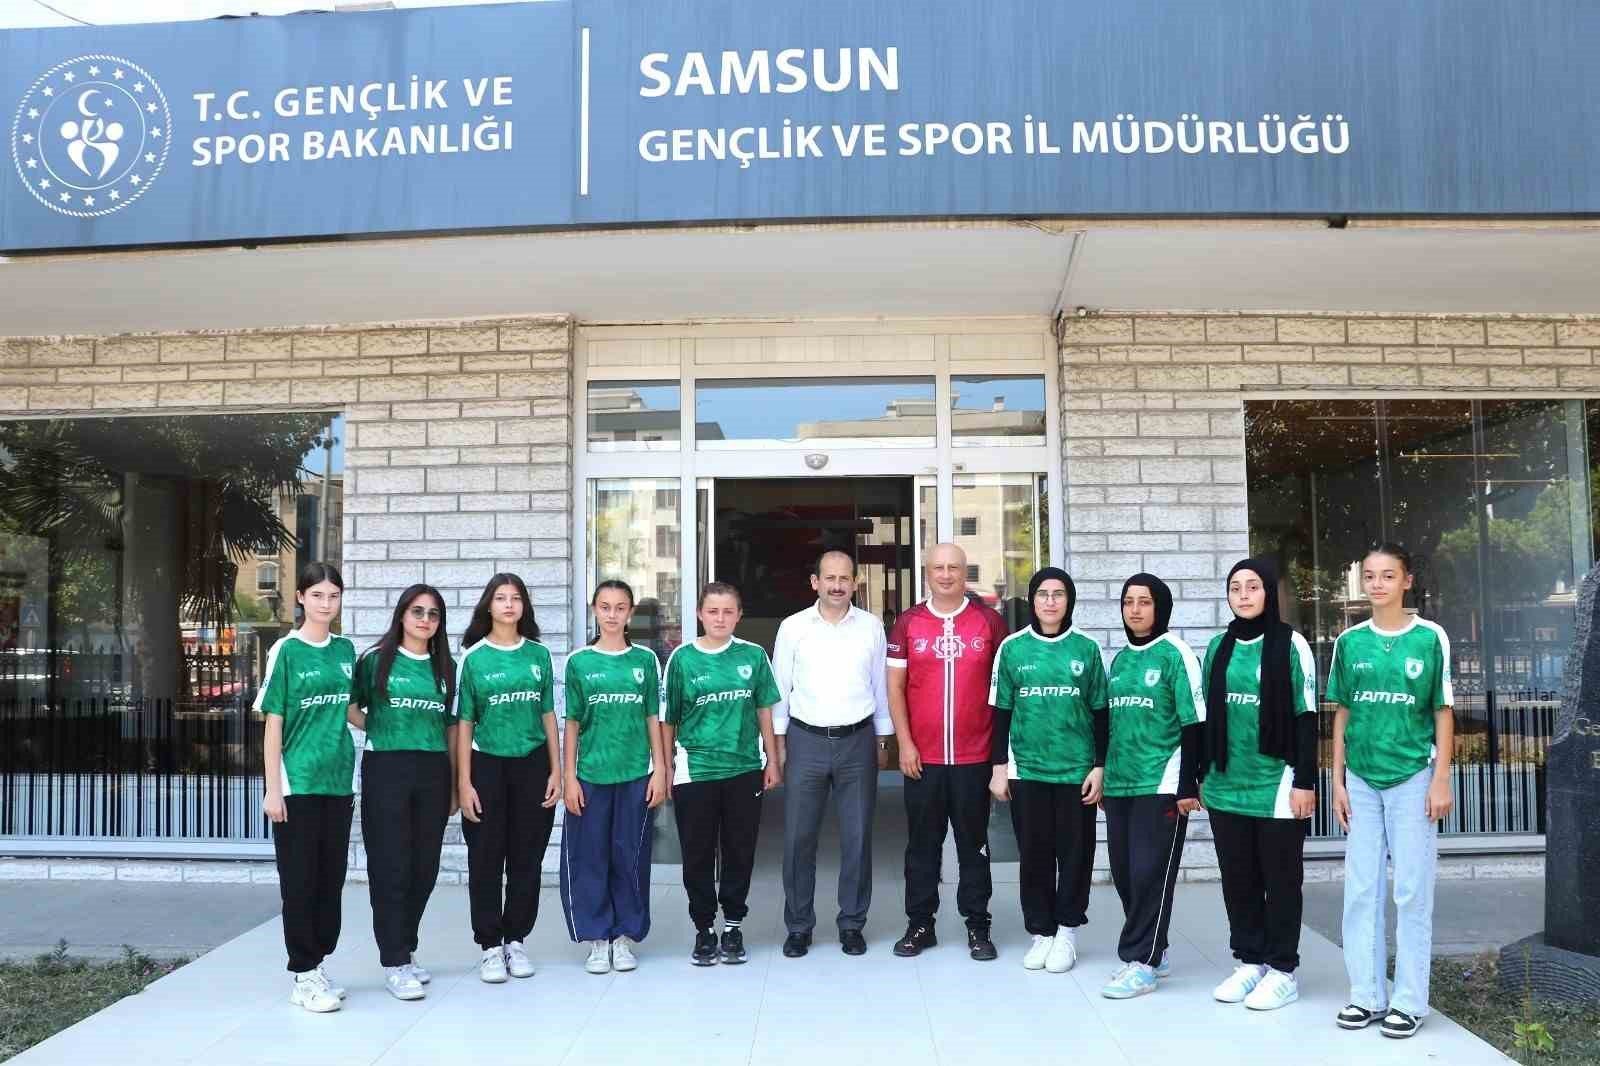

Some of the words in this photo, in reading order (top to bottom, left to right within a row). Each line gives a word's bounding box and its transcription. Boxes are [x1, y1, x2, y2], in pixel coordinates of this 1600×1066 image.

[639, 46, 899, 98] SAMSUN
[192, 92, 262, 122] T.C.
[273, 74, 448, 122] GENÇLİK
[463, 75, 513, 108] VE
[191, 131, 290, 167] SPOR
[303, 115, 513, 161] BAKANLIĞI
[638, 118, 823, 169] GENÇLİK
[831, 124, 887, 157] VE
[898, 121, 1014, 156] SPOR
[1024, 114, 1061, 154] İL
[1072, 113, 1350, 154] MÜDÜRLÜĞÜ
[488, 691, 541, 706] SAMPA
[588, 693, 644, 705] SAMPA
[695, 689, 752, 706] SAMPA
[1019, 686, 1081, 697] SAMPA
[300, 693, 351, 709] SAMP
